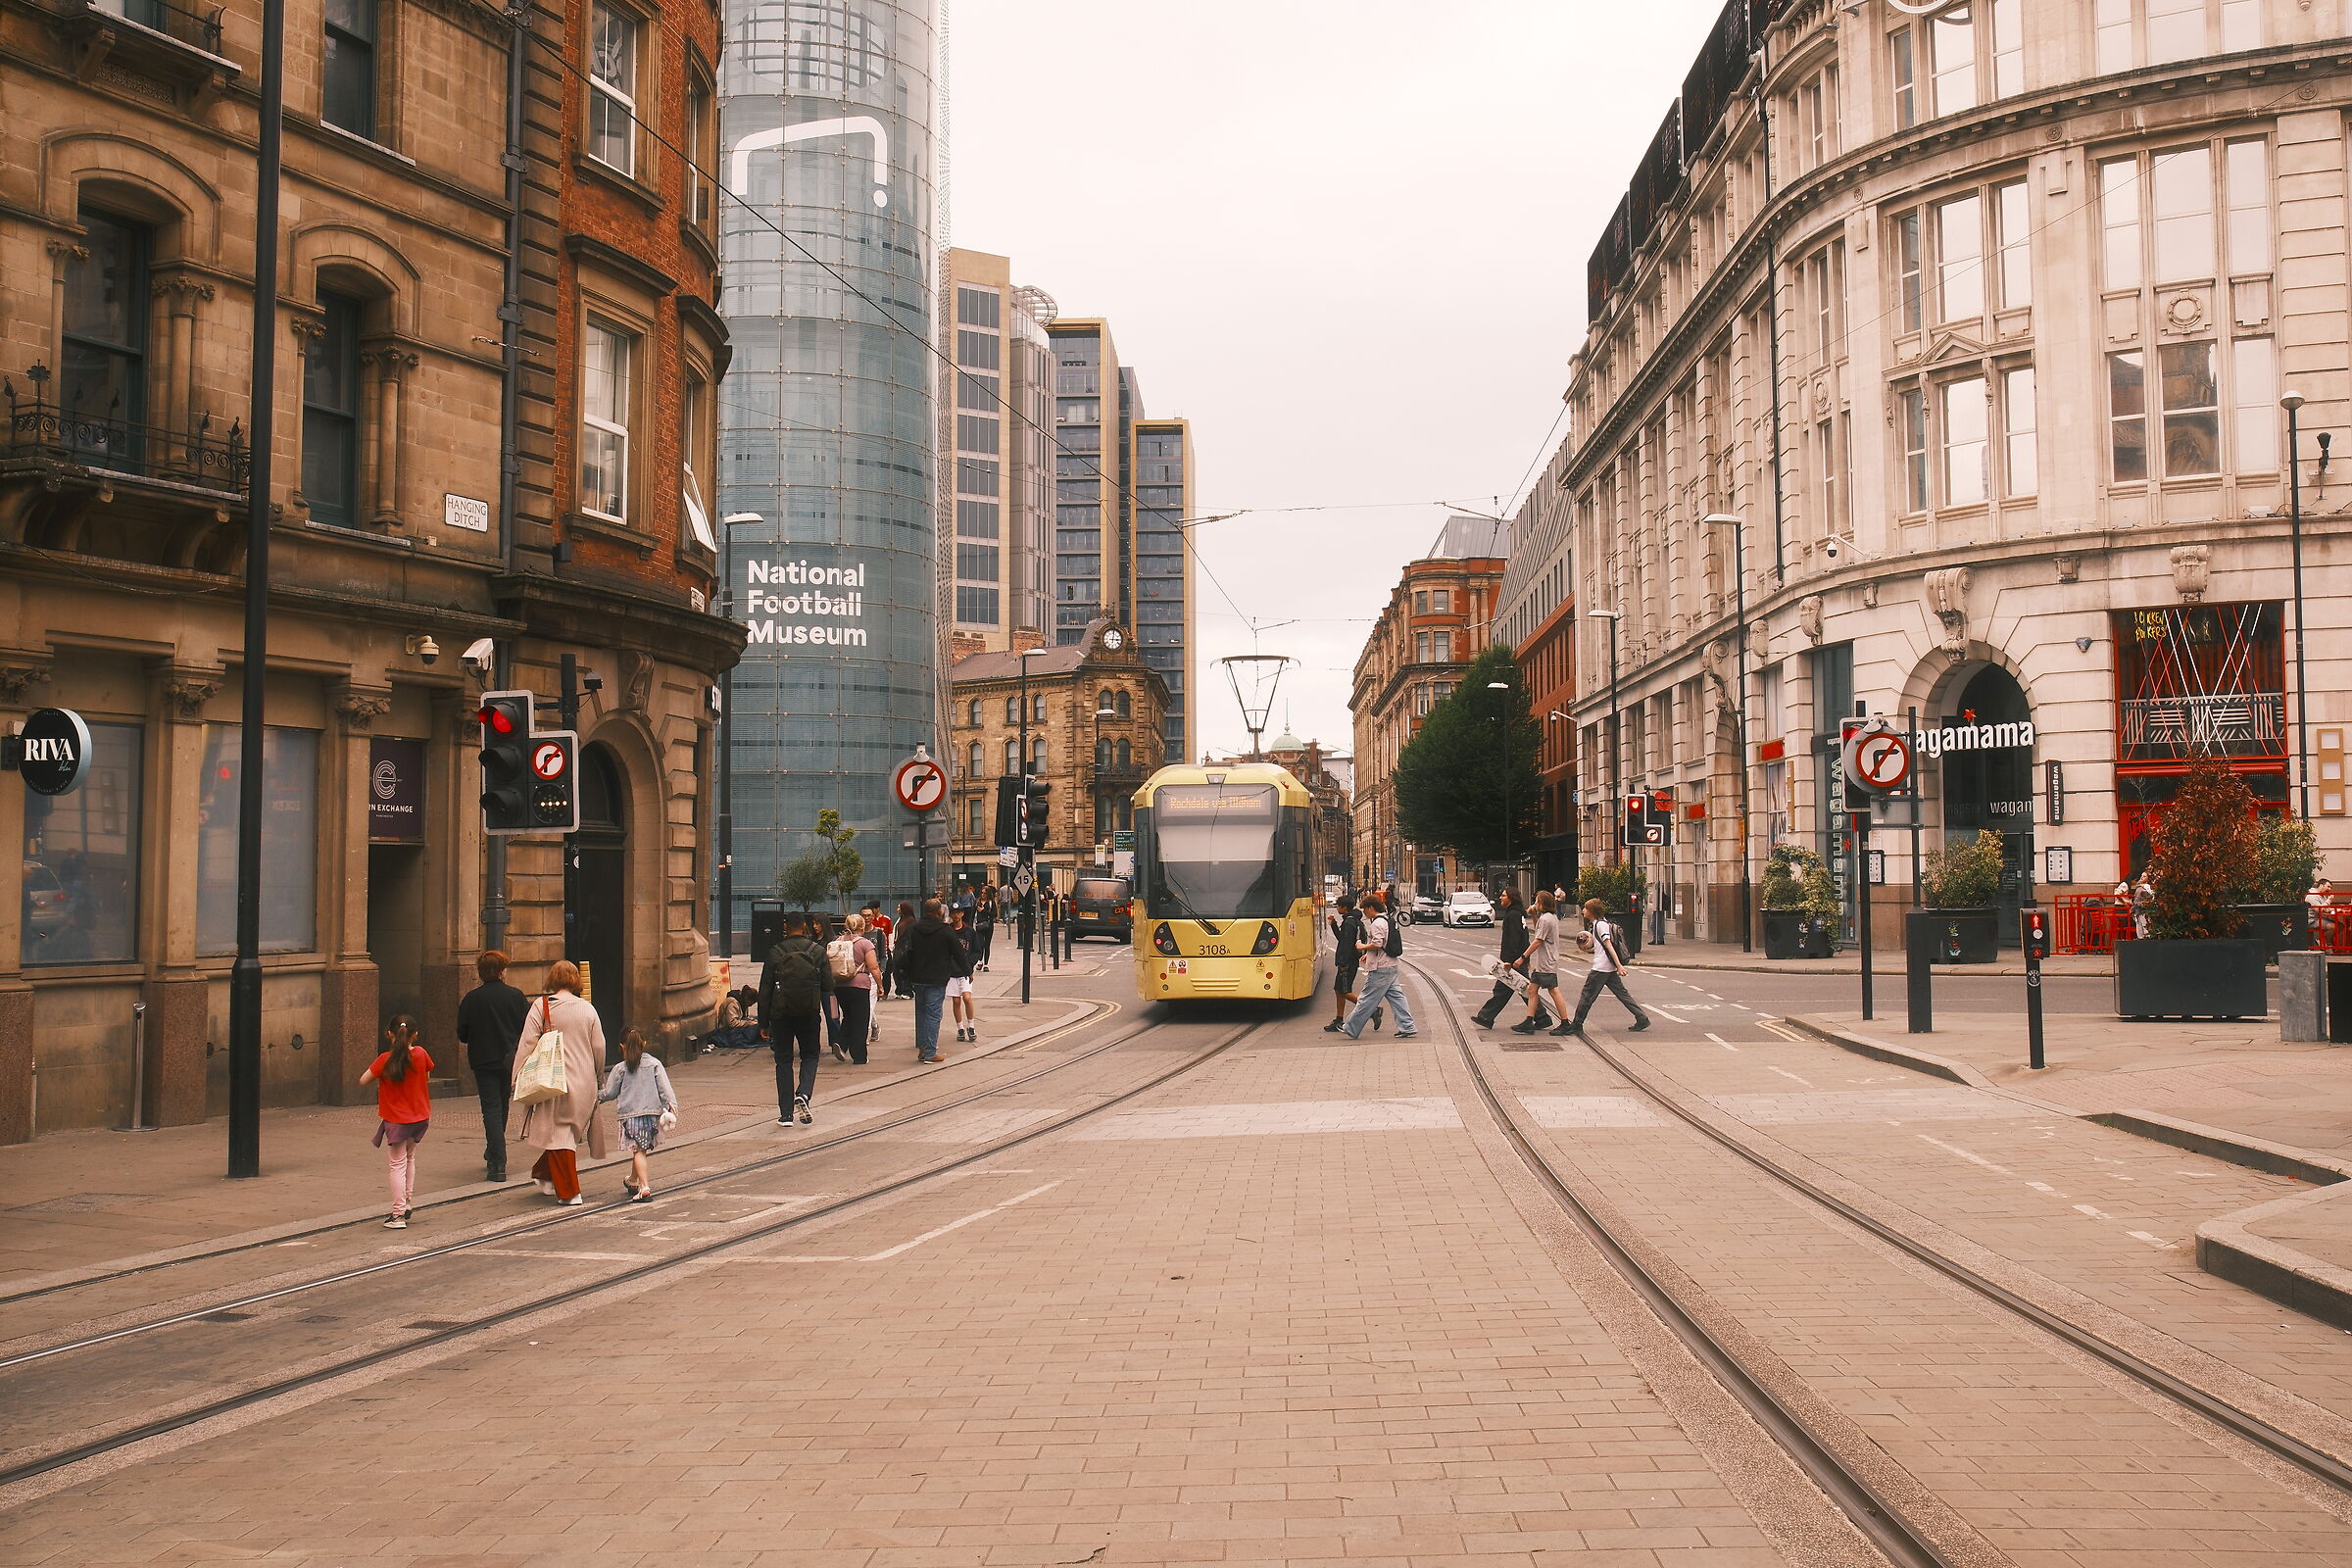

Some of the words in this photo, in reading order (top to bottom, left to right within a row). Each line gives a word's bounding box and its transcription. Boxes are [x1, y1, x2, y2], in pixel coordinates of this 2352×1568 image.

[447, 497, 486, 516] HANGING
[454, 512, 480, 527] DITCH
[748, 560, 864, 587] National
[748, 590, 861, 616] Football
[747, 619, 867, 647] Museum
[24, 738, 75, 761] RIVA
[1904, 720, 2034, 759] agamama
[377, 804, 414, 813] EXCHANGE
[1018, 874, 1029, 885] 15
